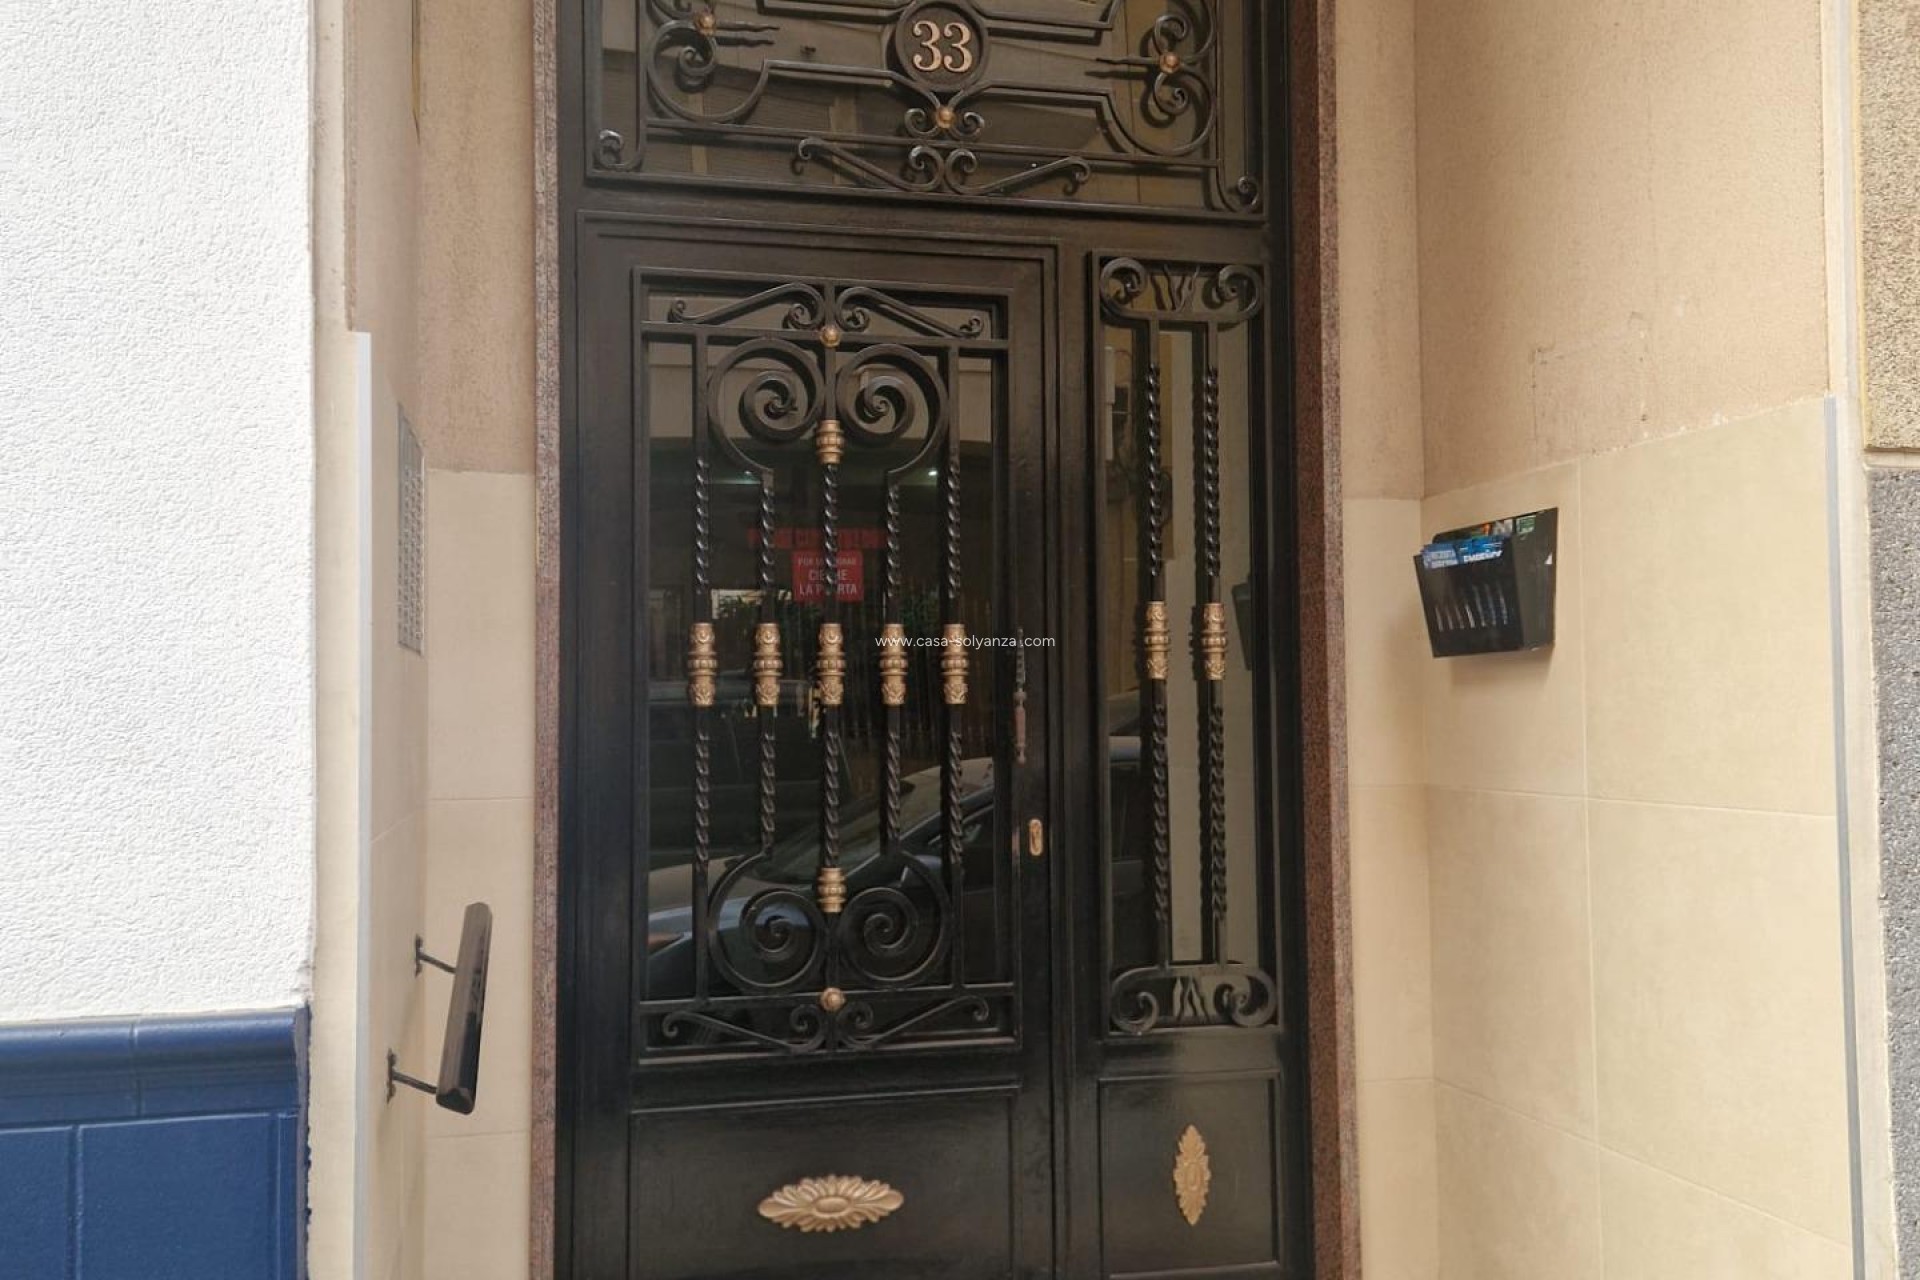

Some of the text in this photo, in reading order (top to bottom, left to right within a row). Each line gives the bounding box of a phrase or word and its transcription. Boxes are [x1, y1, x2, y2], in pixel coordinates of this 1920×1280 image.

[913, 21, 973, 72] 33
[808, 569, 849, 581] CIEE
[799, 584, 857, 595] LA PRTA
